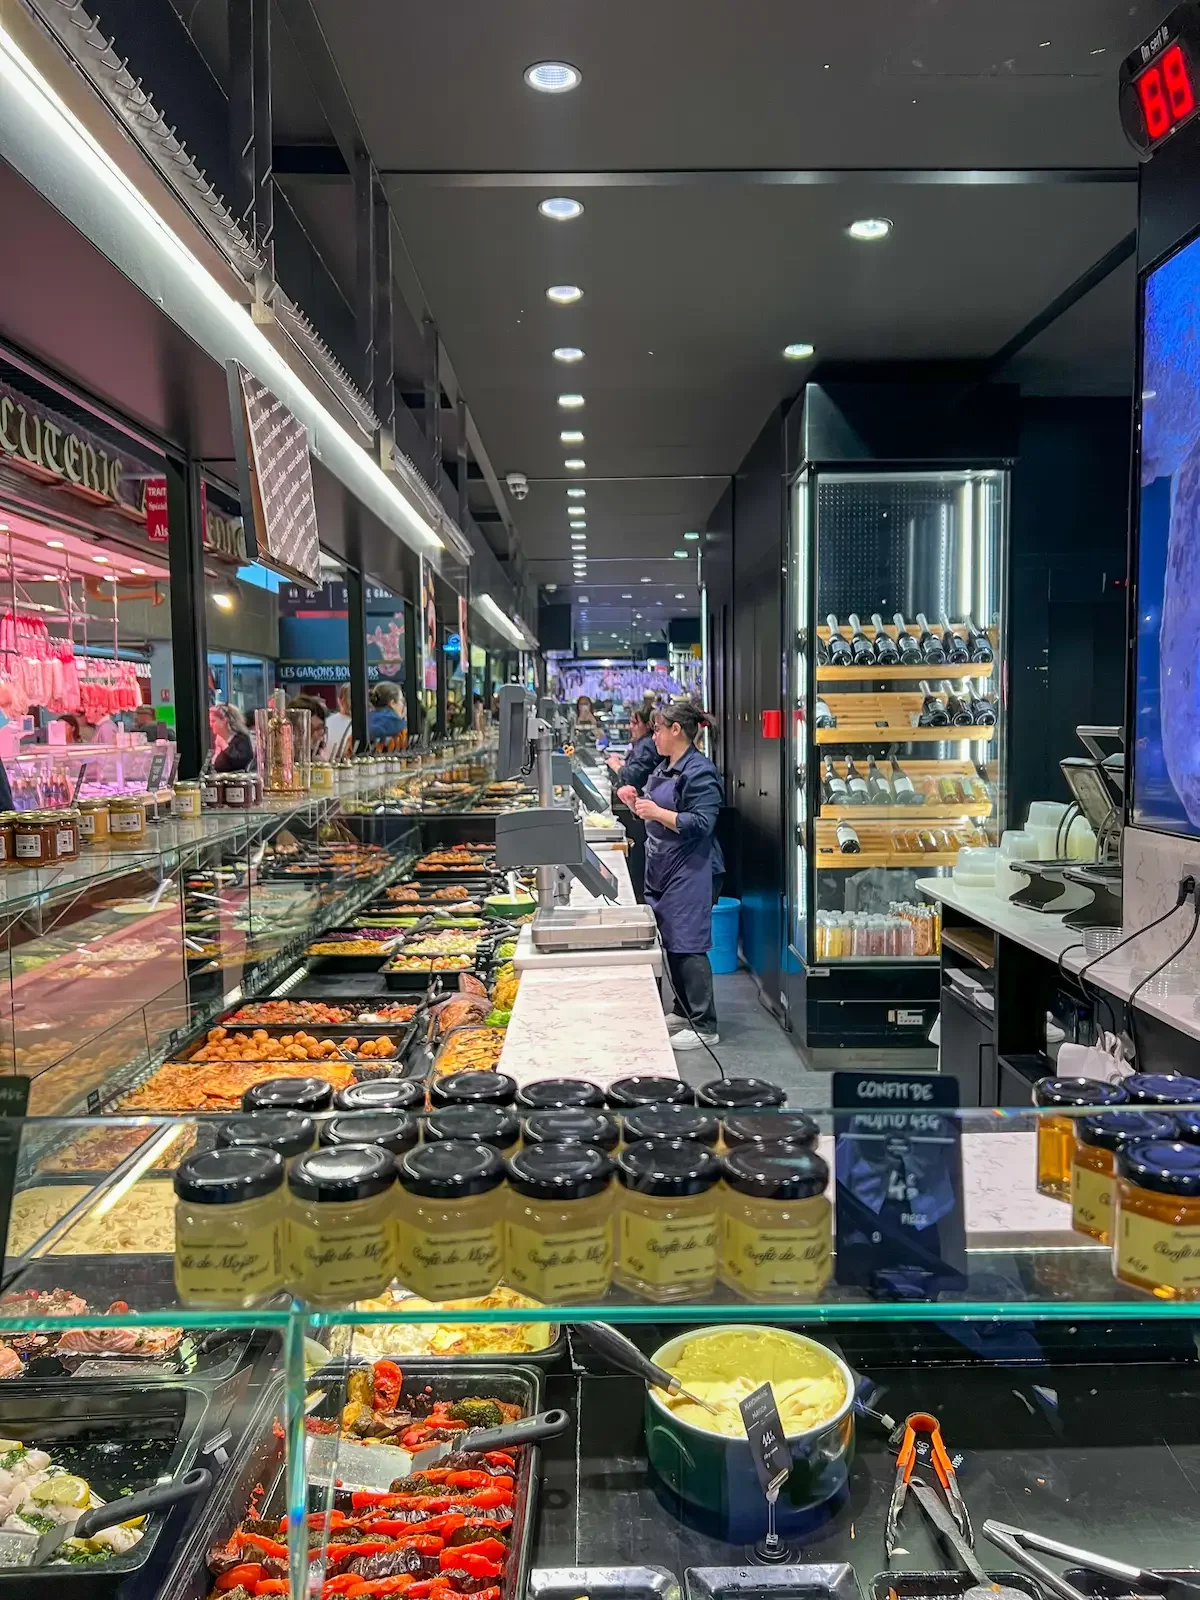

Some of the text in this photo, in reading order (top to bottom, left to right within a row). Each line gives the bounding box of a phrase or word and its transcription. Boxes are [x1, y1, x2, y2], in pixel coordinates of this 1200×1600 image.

[280, 666, 295, 678] LES
[857, 1080, 934, 1101] CONFIT DE
